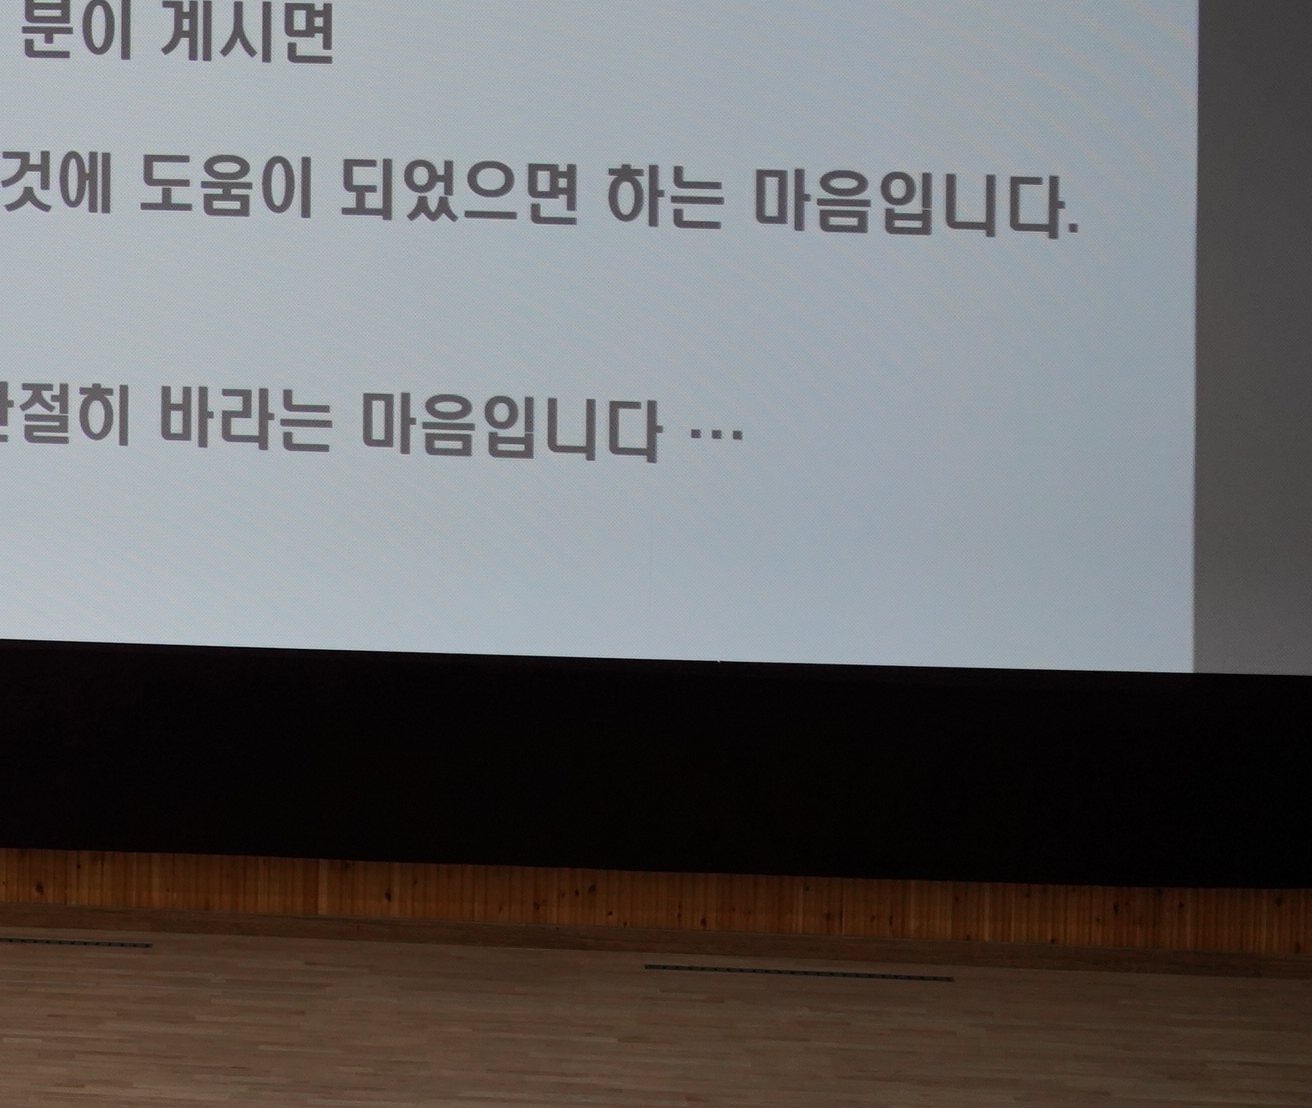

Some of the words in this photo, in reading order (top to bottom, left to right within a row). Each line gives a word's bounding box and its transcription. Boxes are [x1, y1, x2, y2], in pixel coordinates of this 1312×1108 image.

[161, 0, 333, 64] 계시면
[1, 150, 111, 214] 것에
[140, 154, 311, 219] 도움이
[341, 158, 577, 225] 되었으면
[608, 164, 724, 230] 하는
[755, 168, 1078, 240] 마음입니다.
[161, 386, 332, 452] 바라는
[362, 392, 663, 464] 마음입니다
